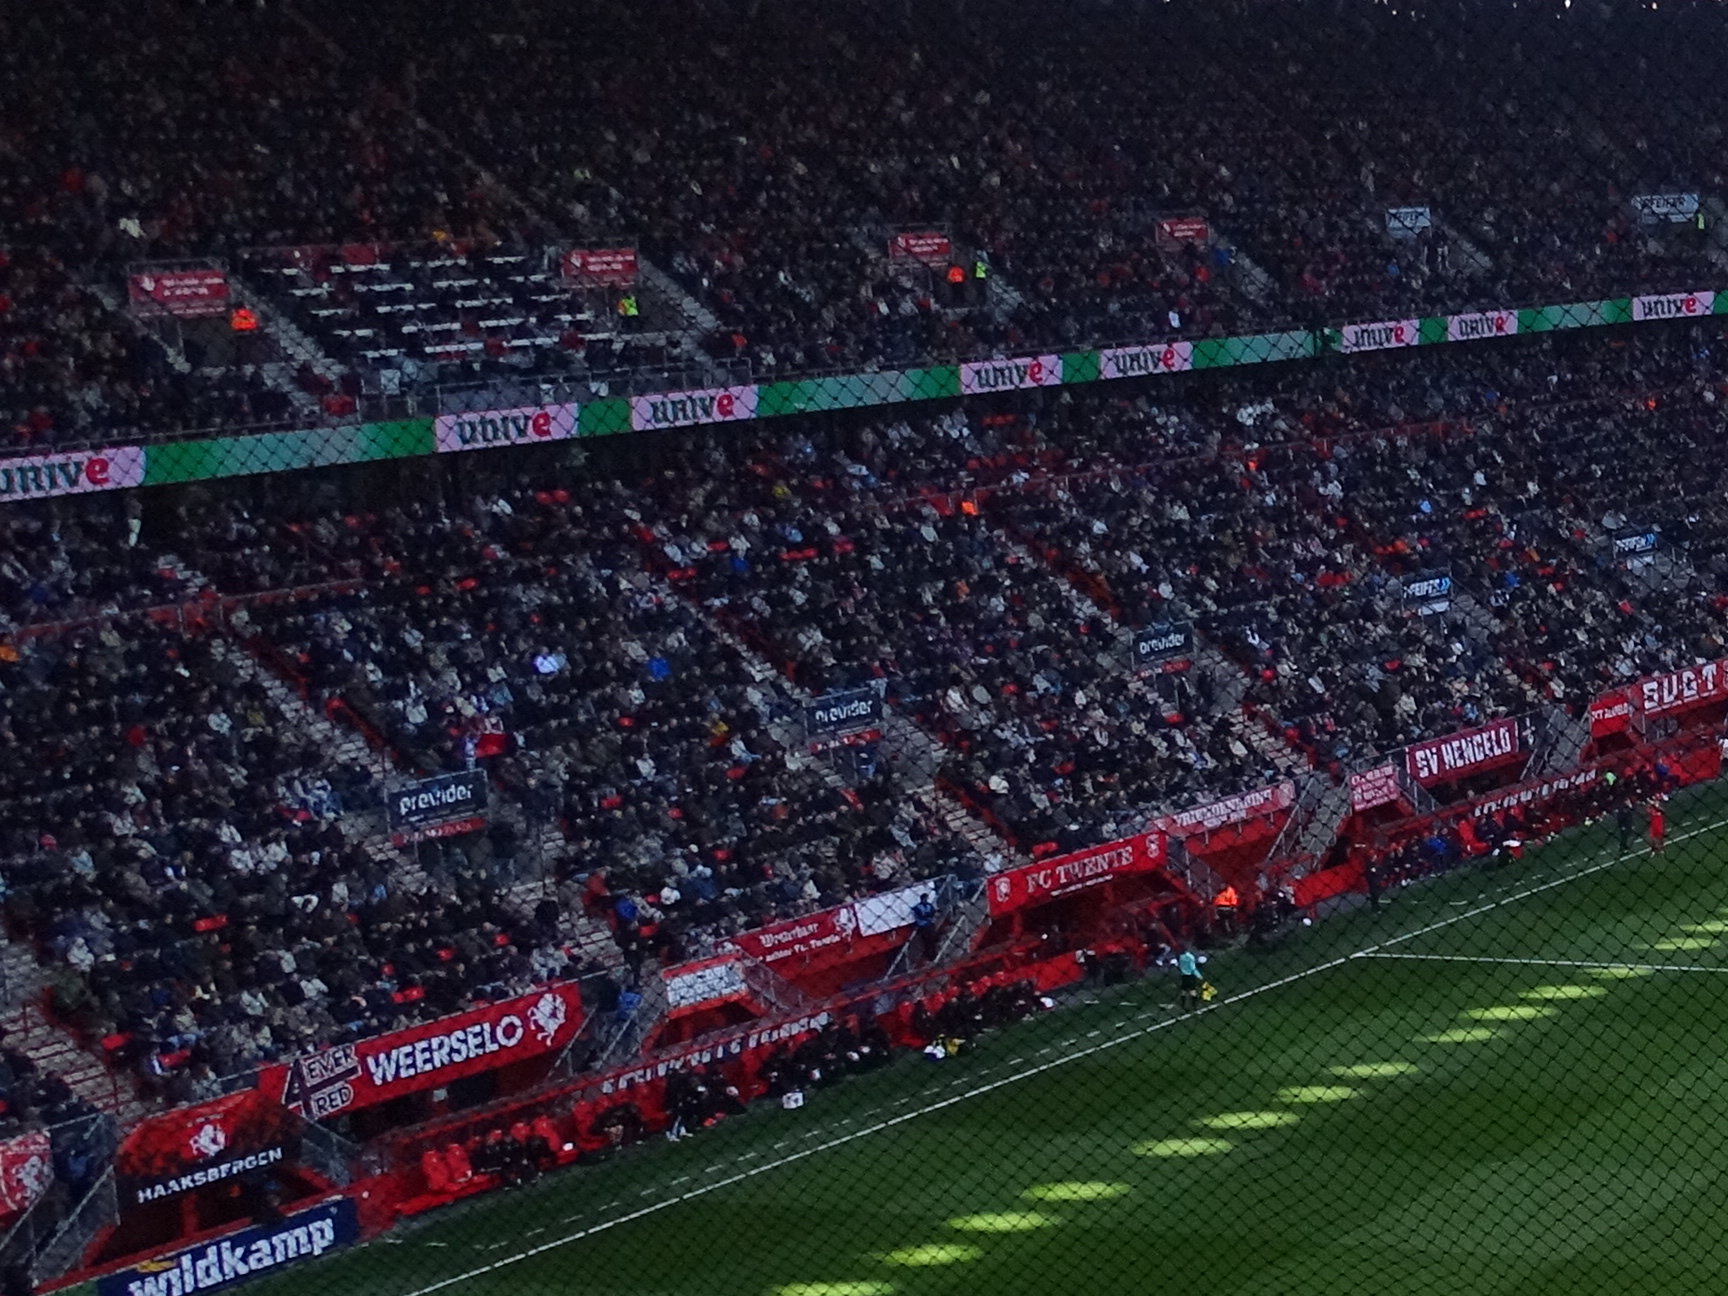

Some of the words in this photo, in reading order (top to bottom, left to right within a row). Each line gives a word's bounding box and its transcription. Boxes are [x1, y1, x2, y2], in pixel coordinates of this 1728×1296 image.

[1415, 747, 1438, 778] SV
[1441, 727, 1511, 771] HENGELO
[399, 783, 474, 816] previder
[1027, 870, 1052, 894] FC
[1056, 846, 1134, 884] TWENTE
[367, 1014, 525, 1085] WEERSELO
[315, 1086, 351, 1115] RED
[137, 1147, 283, 1204] HAAKSBERGEN
